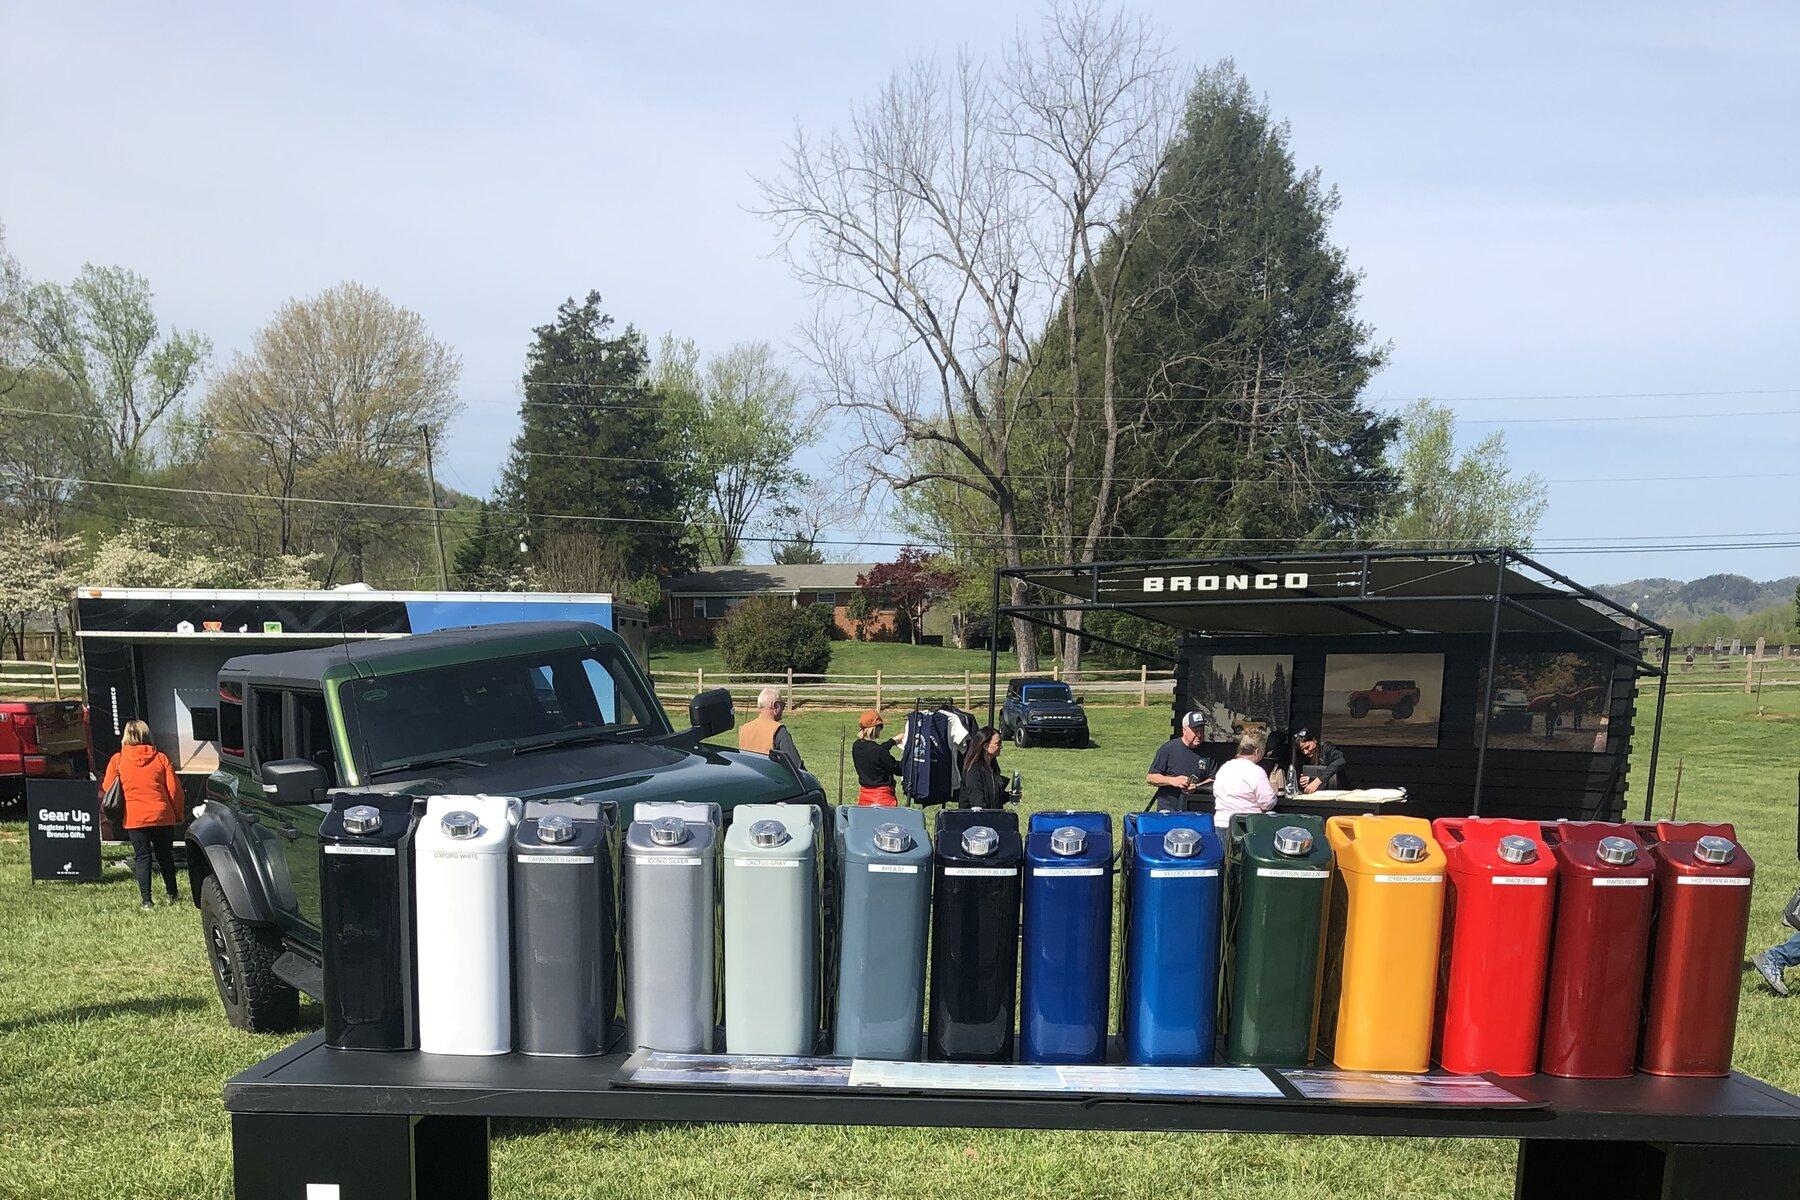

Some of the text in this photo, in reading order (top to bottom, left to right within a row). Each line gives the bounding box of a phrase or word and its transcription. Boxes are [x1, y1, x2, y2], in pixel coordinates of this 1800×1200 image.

[1143, 573, 1308, 592] BRONCO
[38, 809, 90, 823] Gear Up
